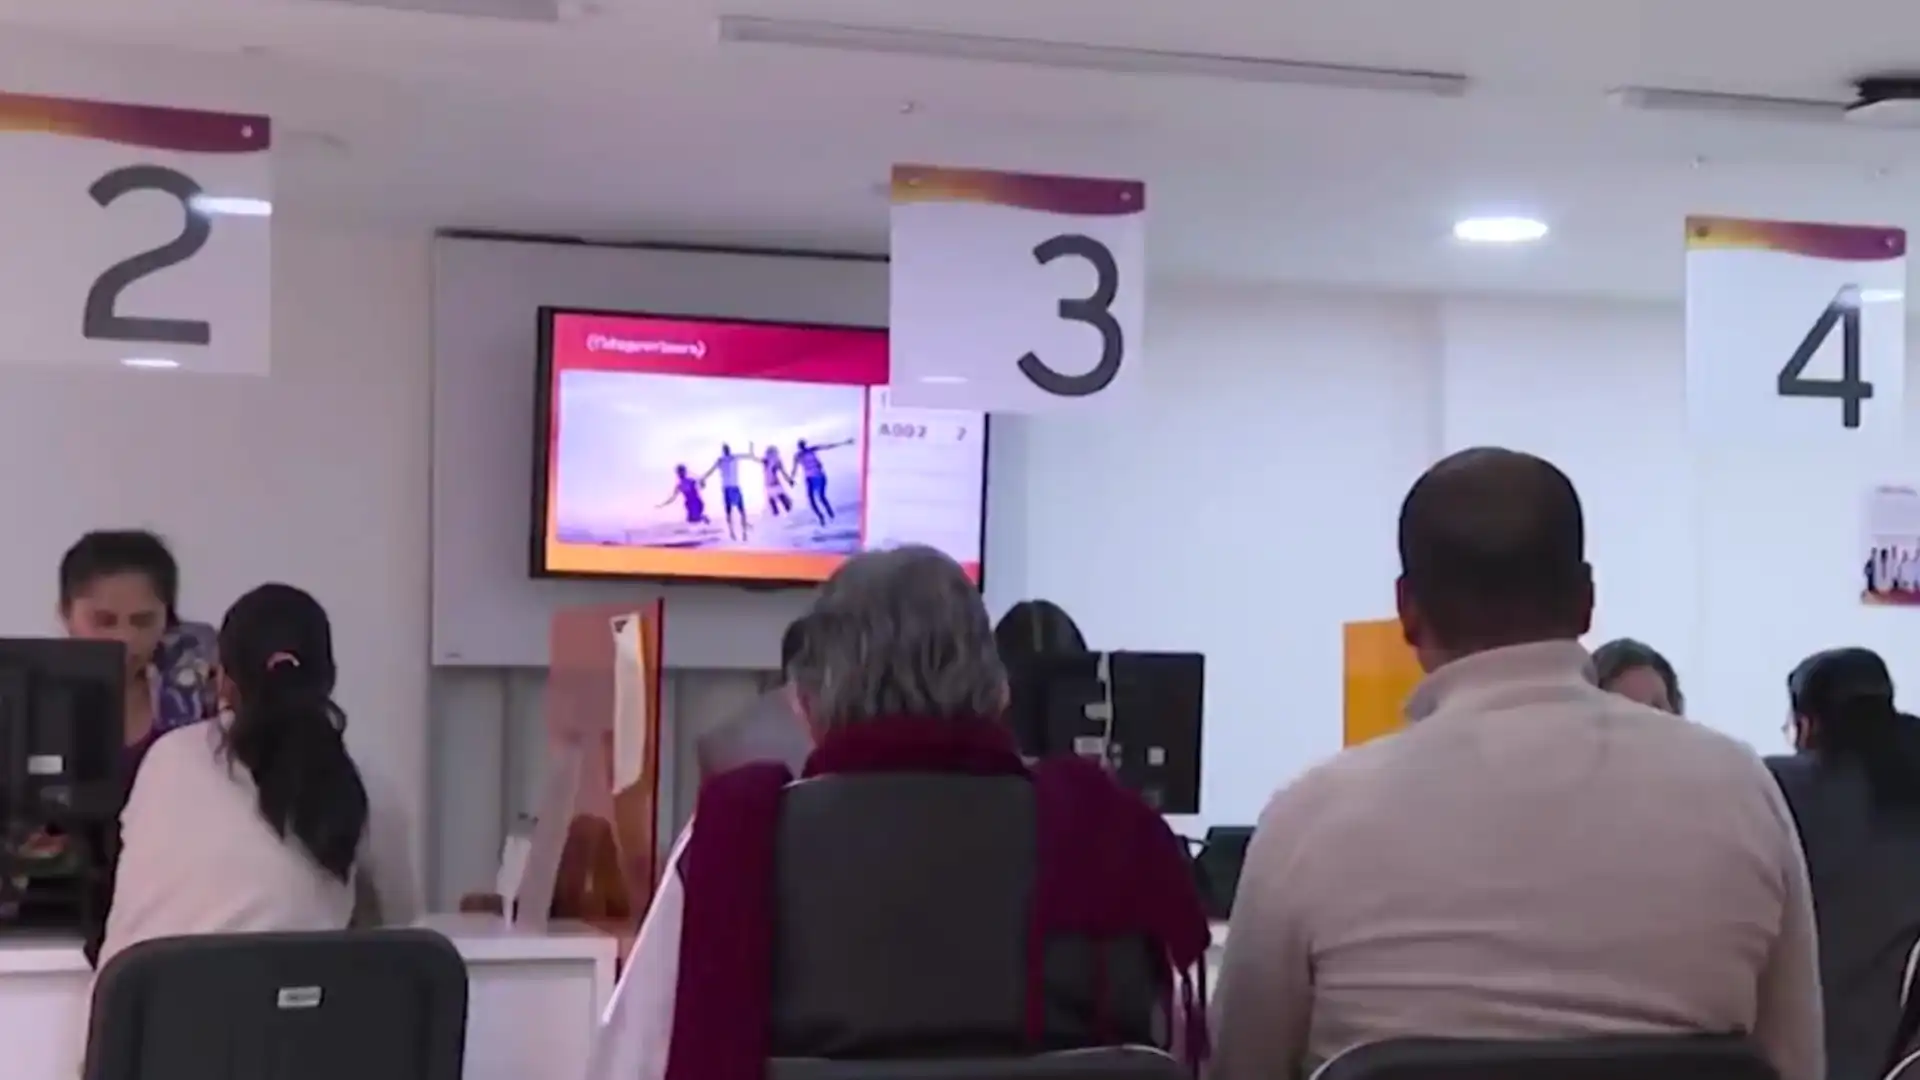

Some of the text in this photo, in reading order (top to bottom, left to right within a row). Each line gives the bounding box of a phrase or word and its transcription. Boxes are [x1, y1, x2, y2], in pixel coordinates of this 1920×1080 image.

[83, 165, 210, 345] 2
[1017, 234, 1123, 397] 3
[1778, 283, 1873, 428] 4
